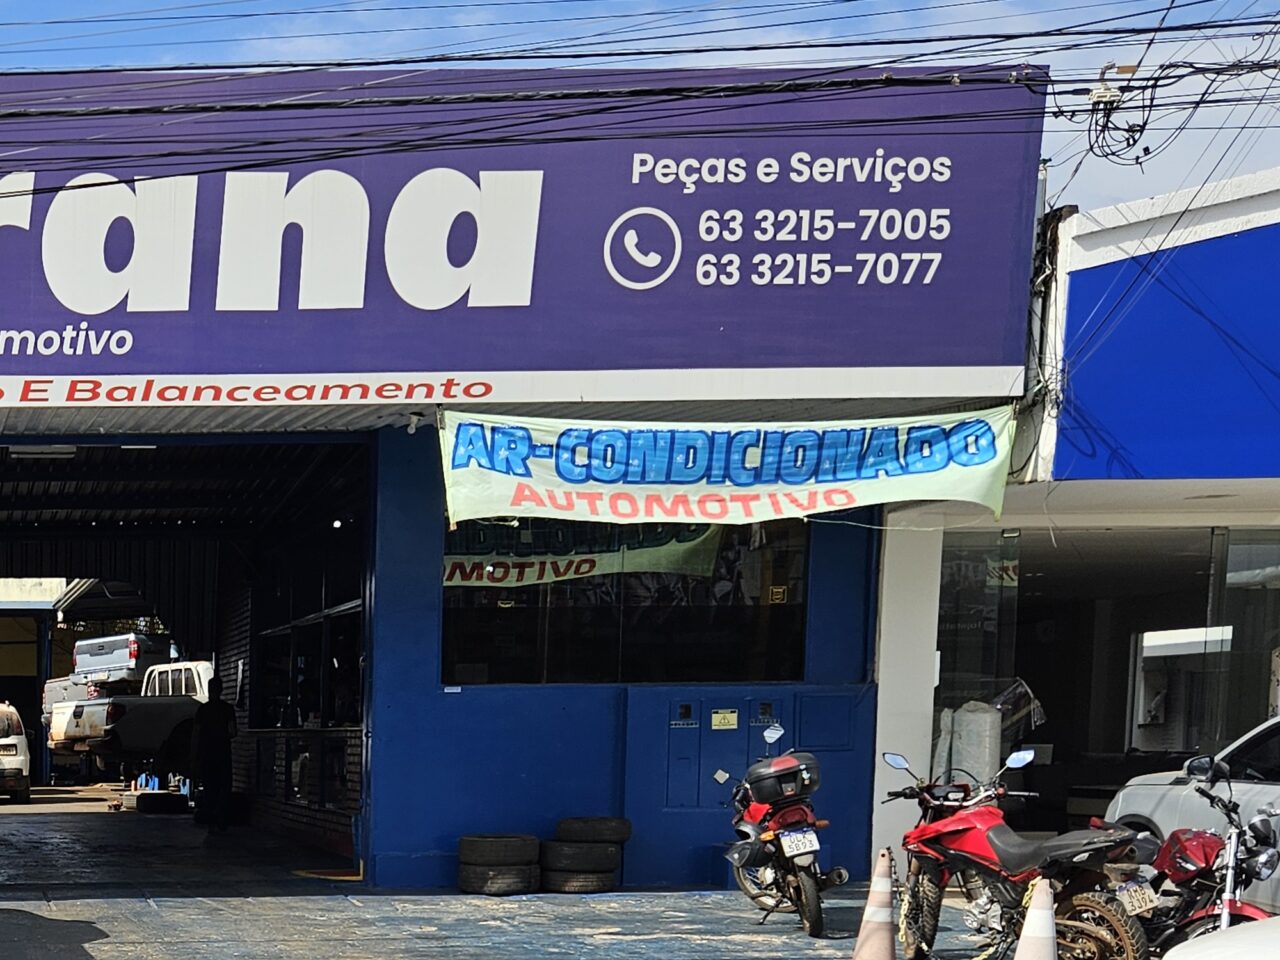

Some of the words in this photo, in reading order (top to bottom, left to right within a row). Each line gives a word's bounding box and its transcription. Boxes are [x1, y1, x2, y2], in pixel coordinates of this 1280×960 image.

[632, 153, 746, 193] Peças
[756, 157, 779, 183] e
[789, 148, 952, 192] Serviços
[698, 209, 744, 242] 63
[753, 208, 951, 241] 3215-7005
[695, 253, 741, 286] 63
[751, 252, 942, 285] 3215-7077
[19, 380, 54, 402] E
[65, 378, 493, 402] Balanceamento
[451, 418, 997, 486] AR-CONDICIONADO
[510, 482, 857, 520] AUTOMOTIVO
